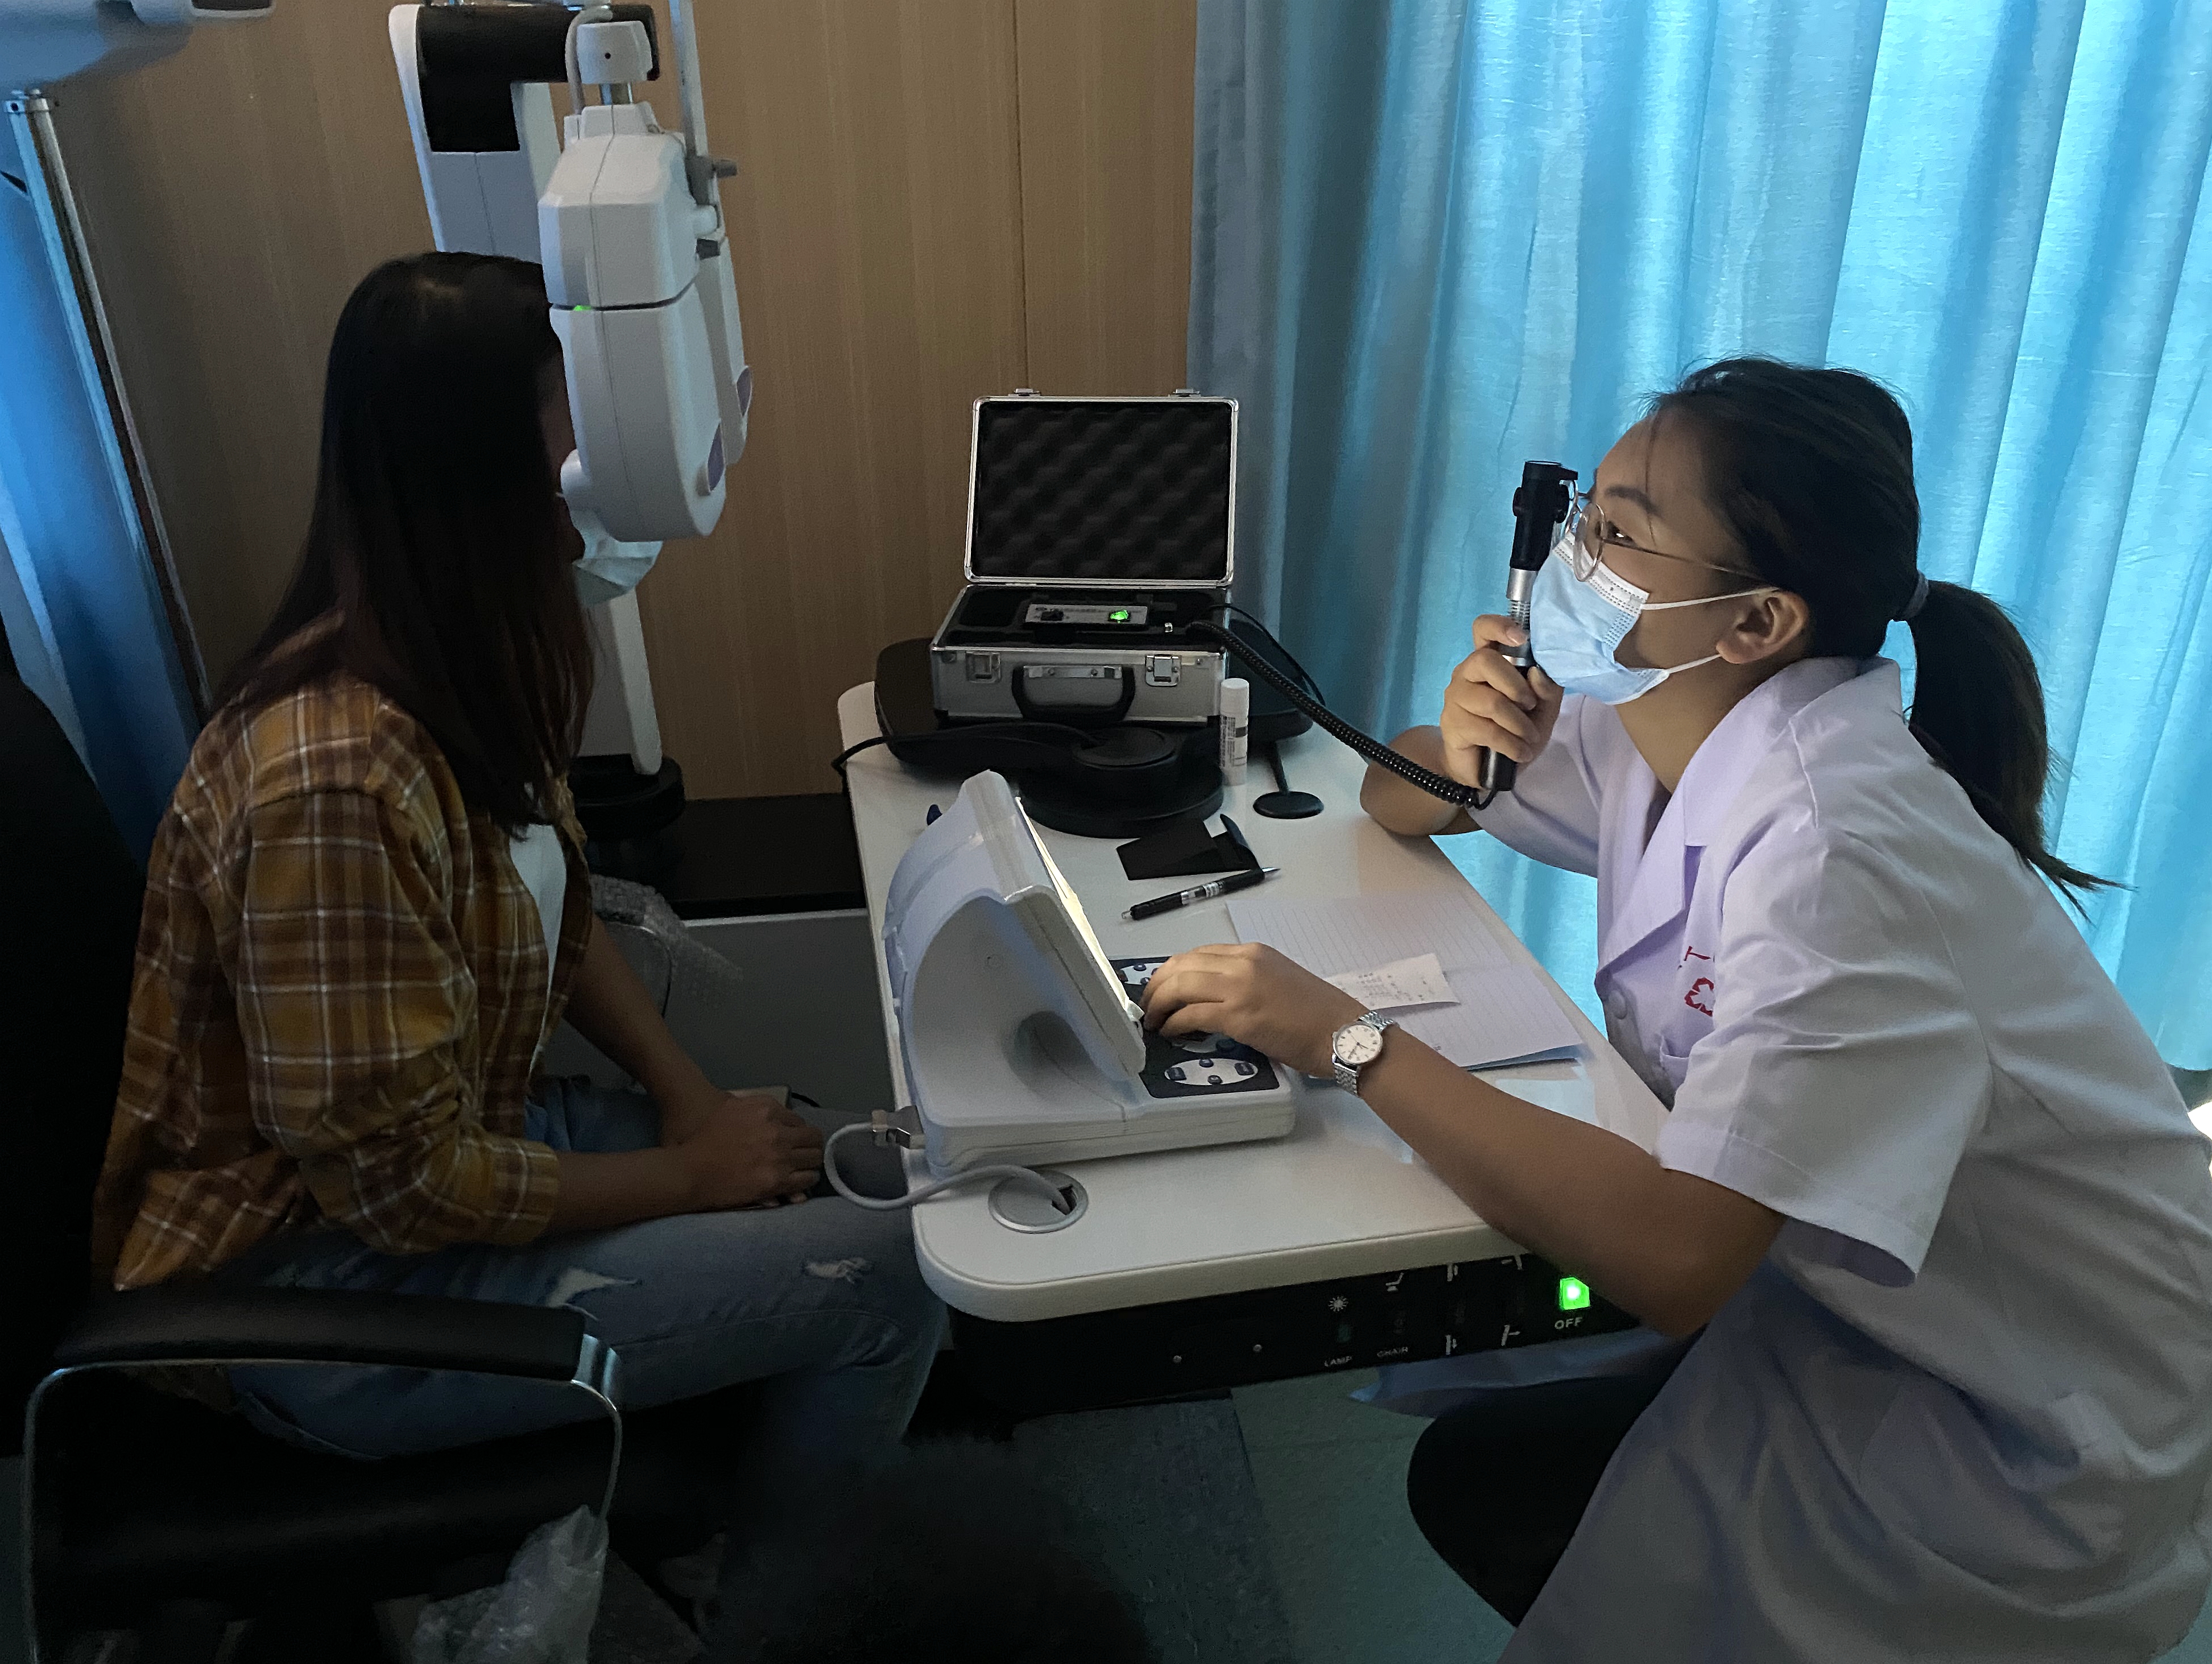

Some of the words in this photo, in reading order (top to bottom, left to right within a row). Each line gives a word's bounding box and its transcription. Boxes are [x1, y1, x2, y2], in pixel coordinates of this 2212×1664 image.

[1554, 1317, 1582, 1329] OFF
[1377, 1346, 1408, 1359] CHAIR
[1324, 1355, 1353, 1367] LAMP
